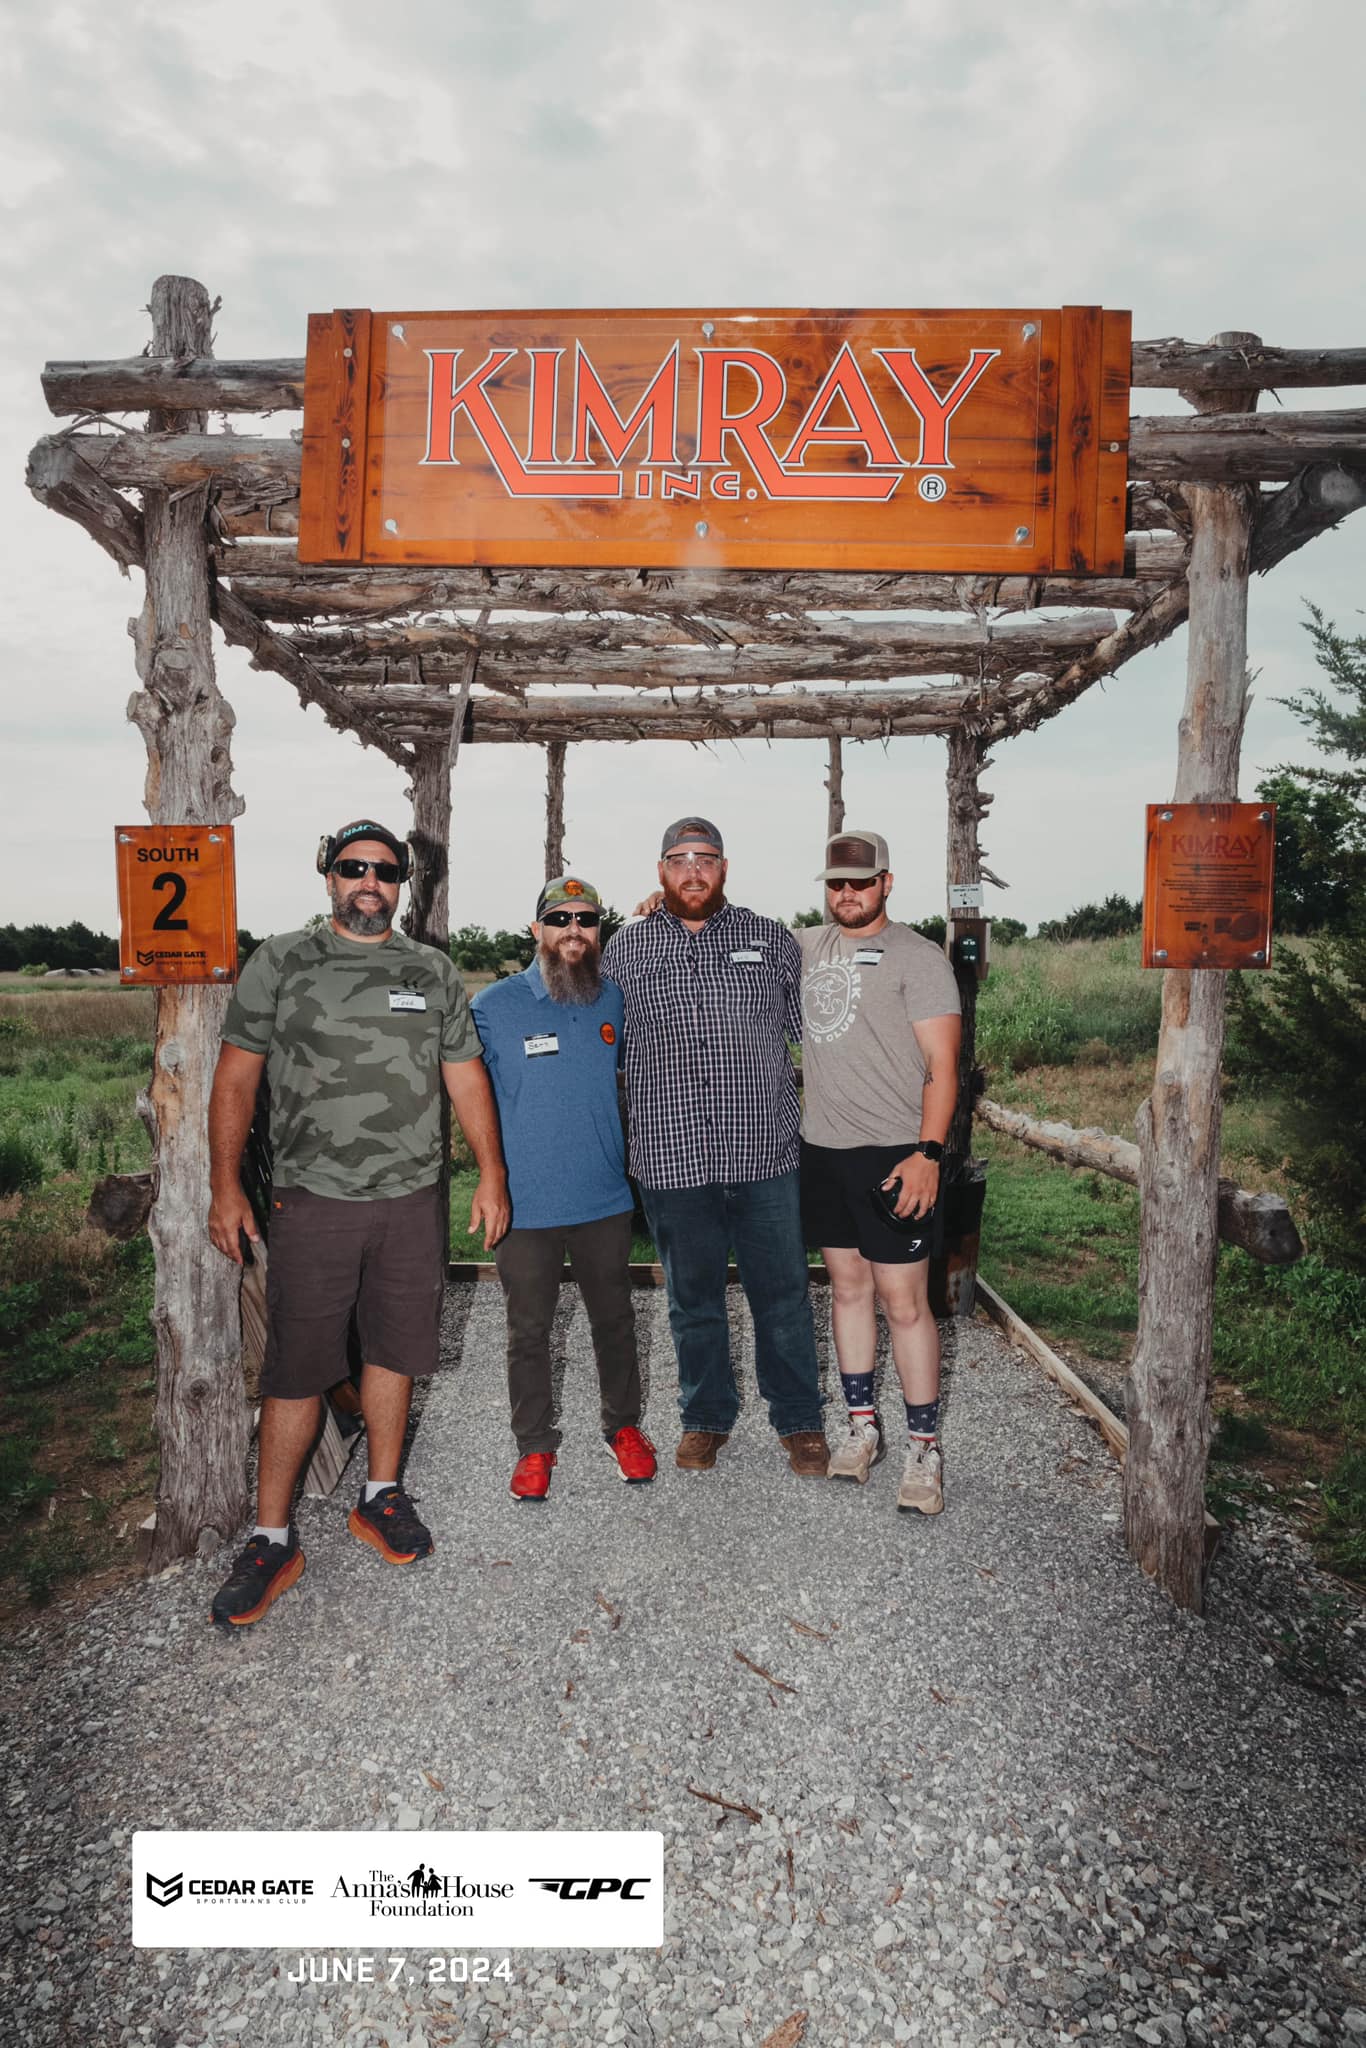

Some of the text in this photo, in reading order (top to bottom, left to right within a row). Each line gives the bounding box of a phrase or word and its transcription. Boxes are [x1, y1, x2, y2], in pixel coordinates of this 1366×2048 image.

[418, 338, 1002, 499] KIMRAY
[635, 470, 758, 500] INC.
[137, 848, 199, 862] SOUTH
[1170, 834, 1263, 859] KIMRAY
[152, 872, 189, 931] 2
